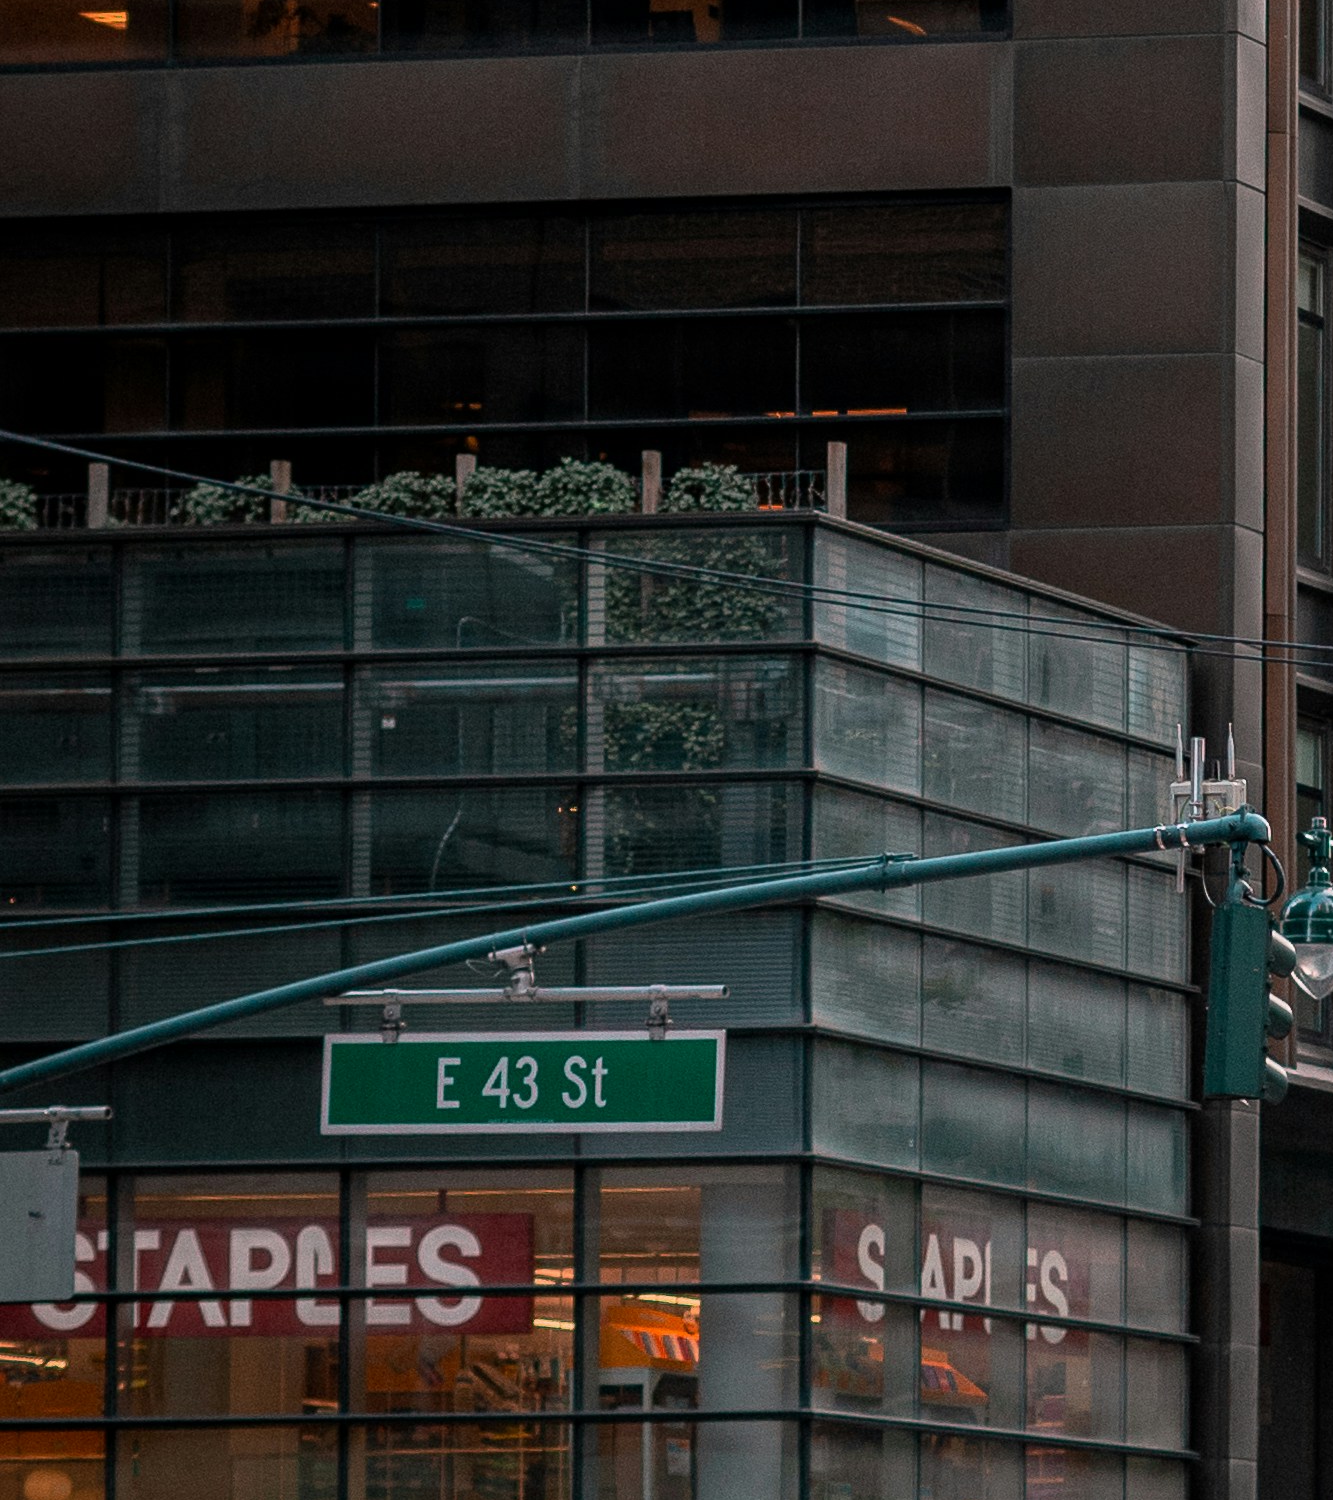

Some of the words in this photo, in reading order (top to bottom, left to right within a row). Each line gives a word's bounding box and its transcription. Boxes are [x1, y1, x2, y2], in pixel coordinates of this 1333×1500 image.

[437, 1057, 461, 1109] E
[481, 1055, 539, 1109] 43
[562, 1055, 608, 1109] St
